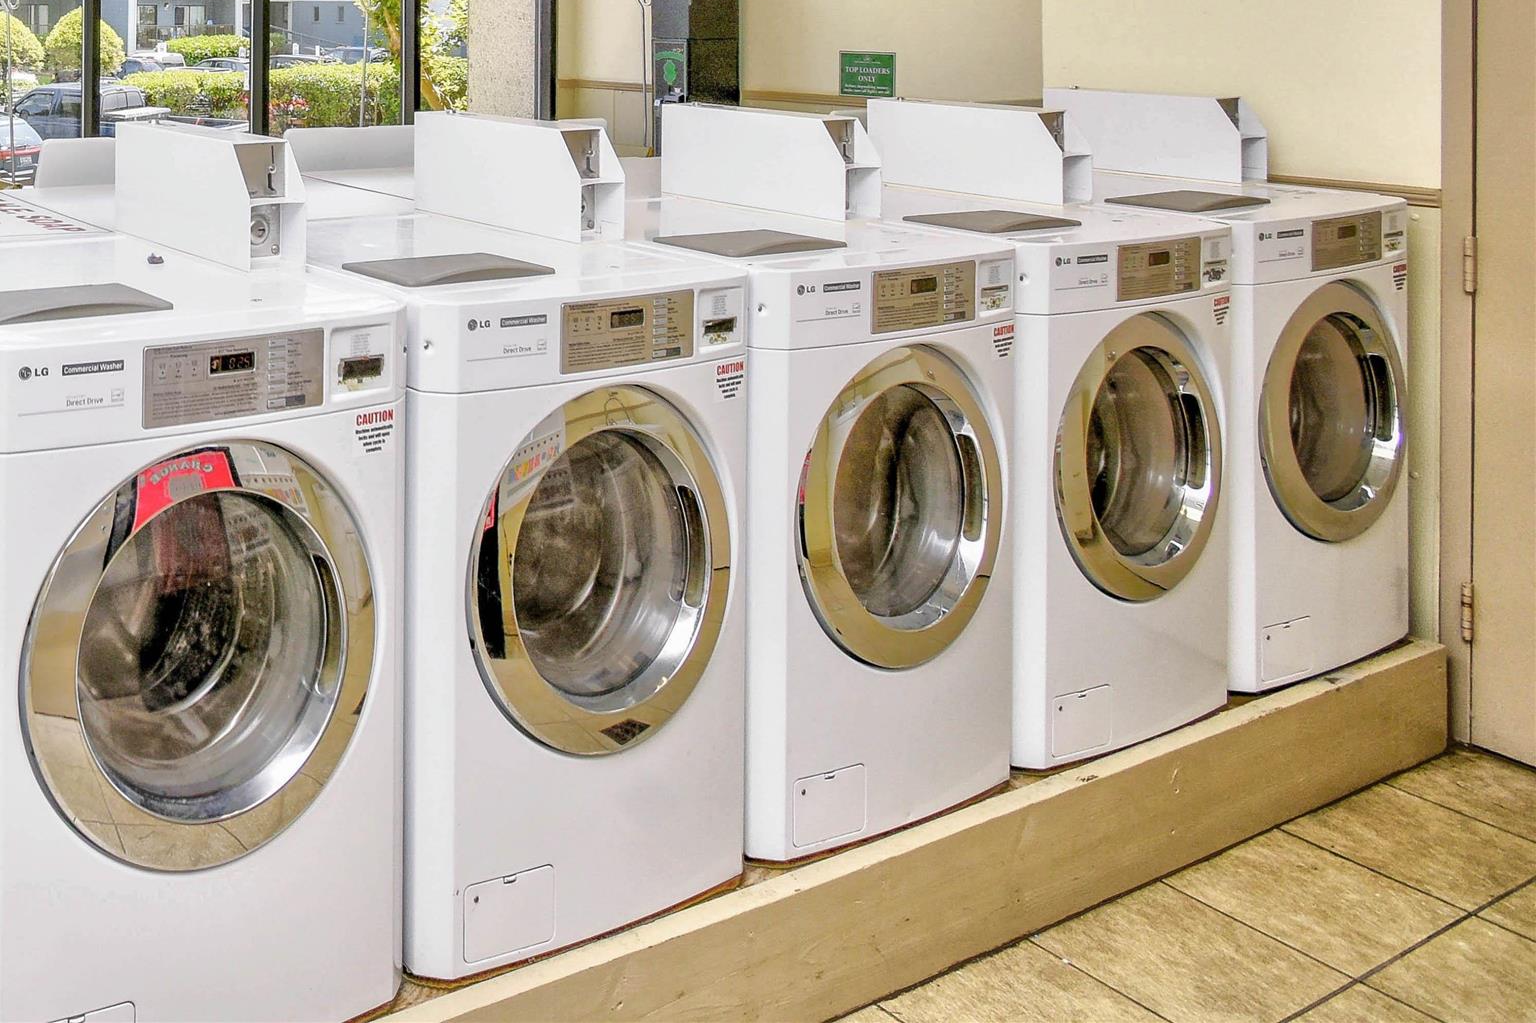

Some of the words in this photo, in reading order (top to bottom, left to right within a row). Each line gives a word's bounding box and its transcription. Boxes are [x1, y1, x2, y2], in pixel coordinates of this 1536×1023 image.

[859, 67, 890, 75] LOADERS
[479, 320, 491, 328] LG
[34, 367, 49, 377] LG
[64, 363, 99, 374] Commercial
[100, 361, 123, 371] Washer
[716, 361, 744, 376] CAUTION
[66, 398, 85, 407] Direct
[87, 396, 104, 405] Drive
[356, 409, 394, 427] CAUTION
